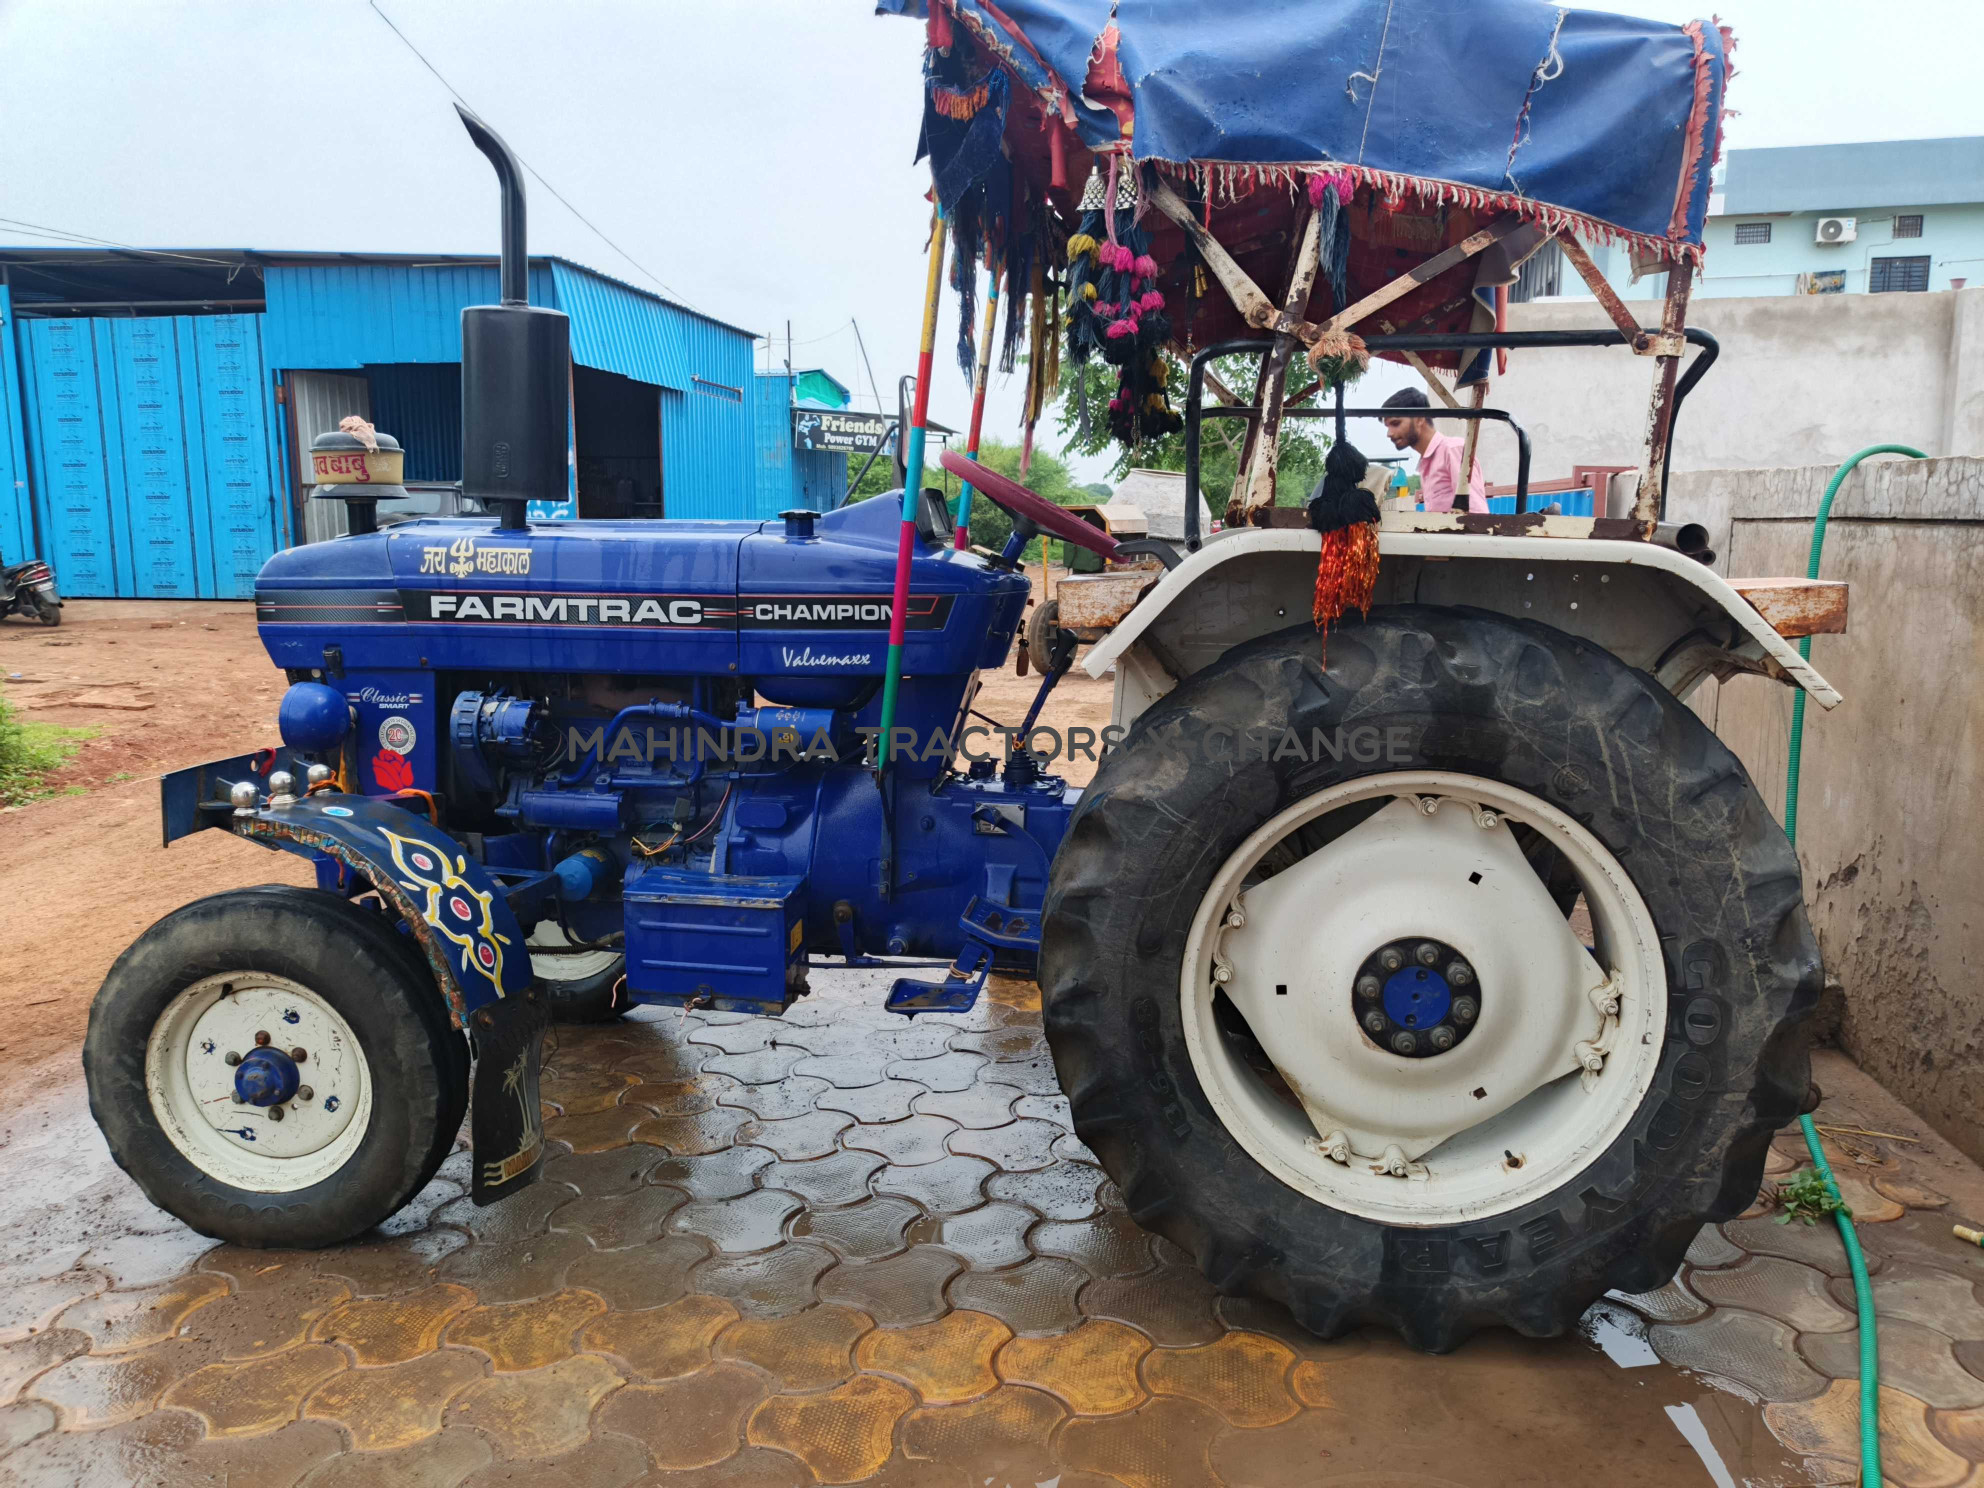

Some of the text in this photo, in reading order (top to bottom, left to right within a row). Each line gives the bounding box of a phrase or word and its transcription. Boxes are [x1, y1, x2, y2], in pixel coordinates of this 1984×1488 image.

[821, 415, 883, 435] Friends
[824, 433, 877, 447] Power GYM
[420, 547, 532, 574] जय महाकाल
[430, 595, 702, 624] FARMTRAC
[755, 604, 893, 621] CHAMPION
[782, 646, 871, 669] Valuemaxx
[361, 687, 409, 704] Classic
[1397, 940, 1724, 1274] GOODYEAR
